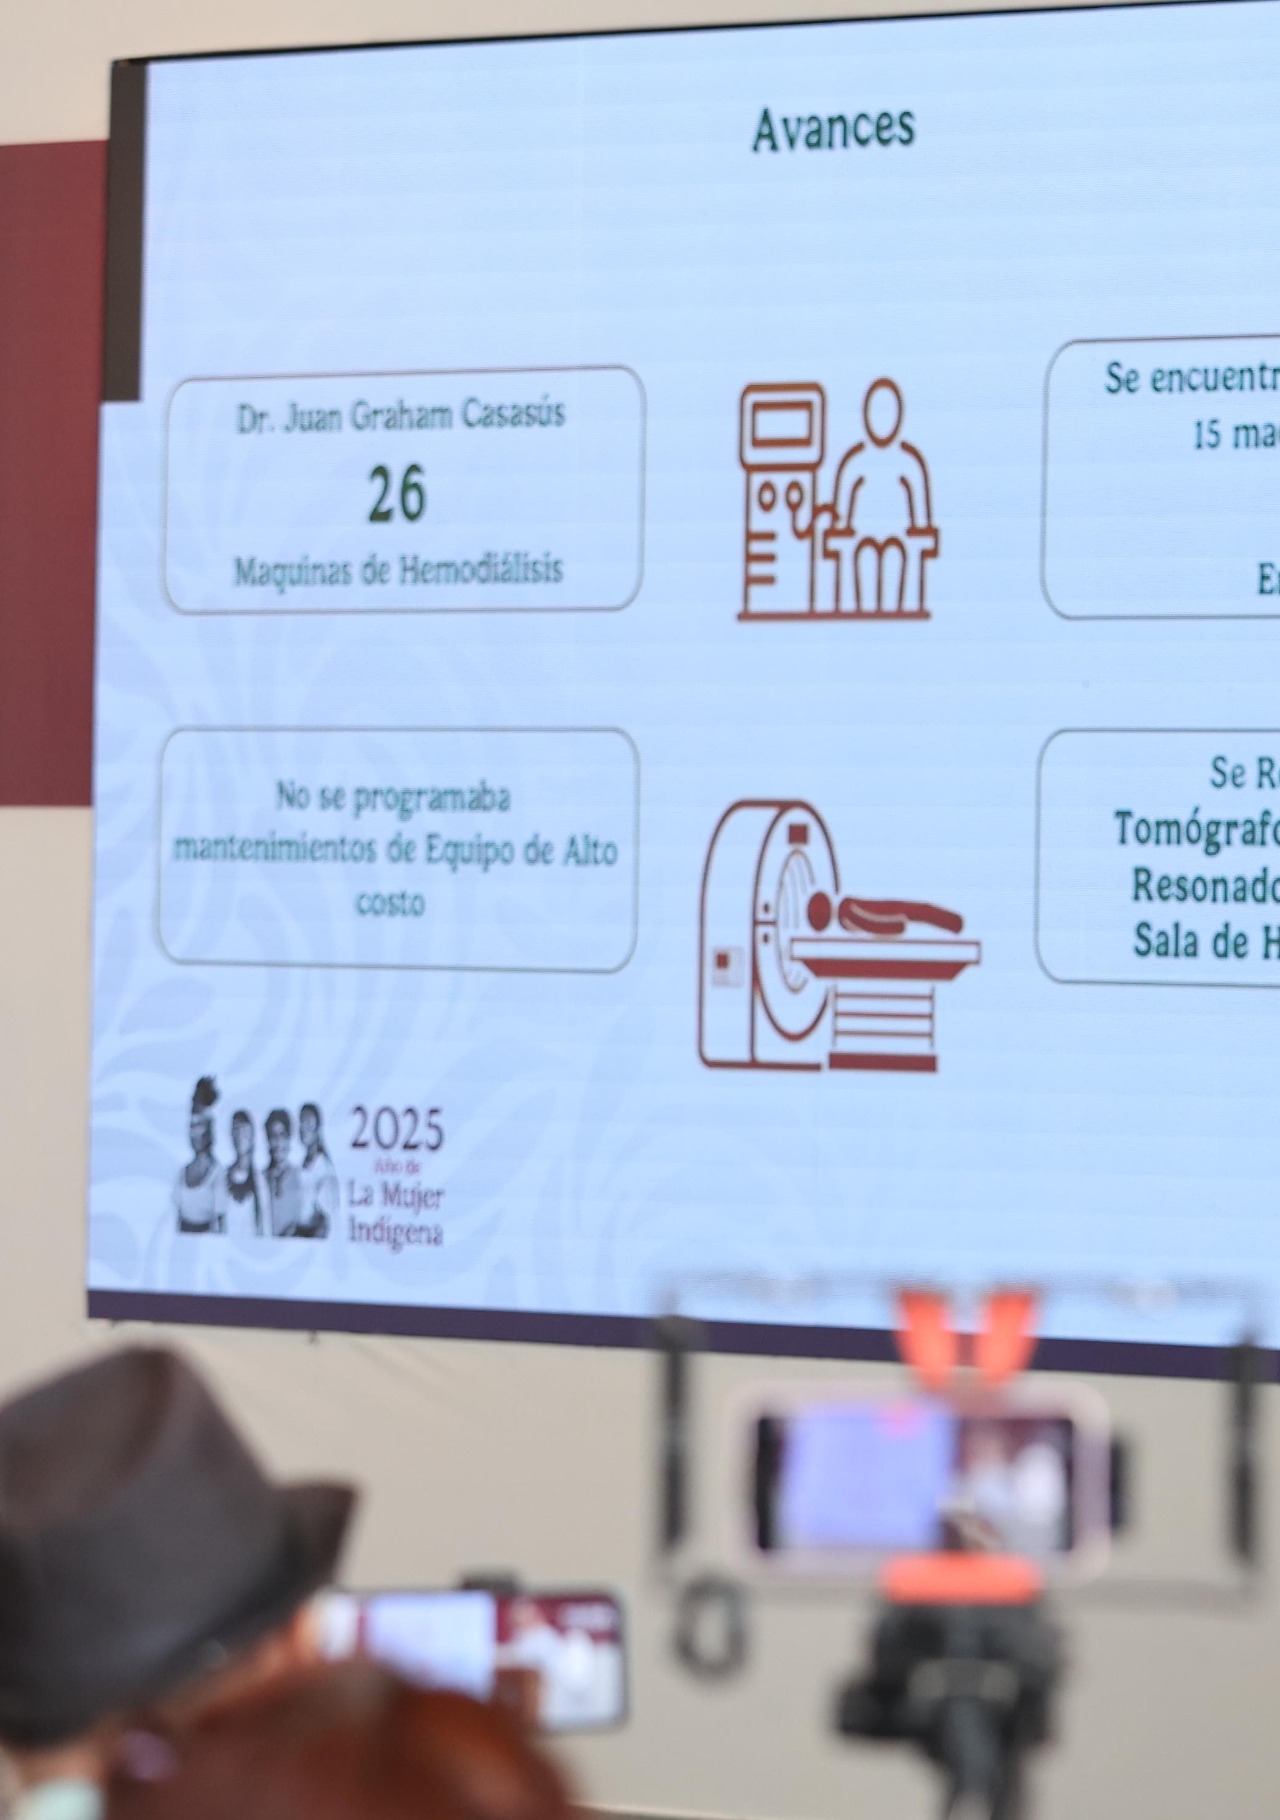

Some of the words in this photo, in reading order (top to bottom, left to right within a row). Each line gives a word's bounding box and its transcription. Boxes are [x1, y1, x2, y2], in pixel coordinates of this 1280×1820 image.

[753, 106, 916, 153] Avances
[1106, 361, 1139, 394] Se
[237, 403, 275, 434] Dr.
[284, 402, 342, 433] Juan
[351, 400, 453, 431] Graham
[461, 396, 565, 428] Casasús
[1196, 419, 1220, 449] 15
[368, 464, 426, 523] 26
[361, 554, 390, 585] de
[1211, 756, 1245, 789] Se
[277, 780, 311, 811] No
[319, 787, 345, 810] se
[353, 780, 510, 819] programaba
[174, 832, 376, 863] mantenimientos
[387, 832, 416, 863] de
[426, 833, 514, 873] Equipo
[523, 834, 553, 865] de
[563, 834, 618, 866] Alto
[355, 890, 425, 917] costo
[1135, 921, 1198, 958] Sala
[1213, 922, 1248, 959] de
[351, 1105, 444, 1151] 2025
[348, 1179, 374, 1207] La
[382, 1180, 445, 1215] Mujer
